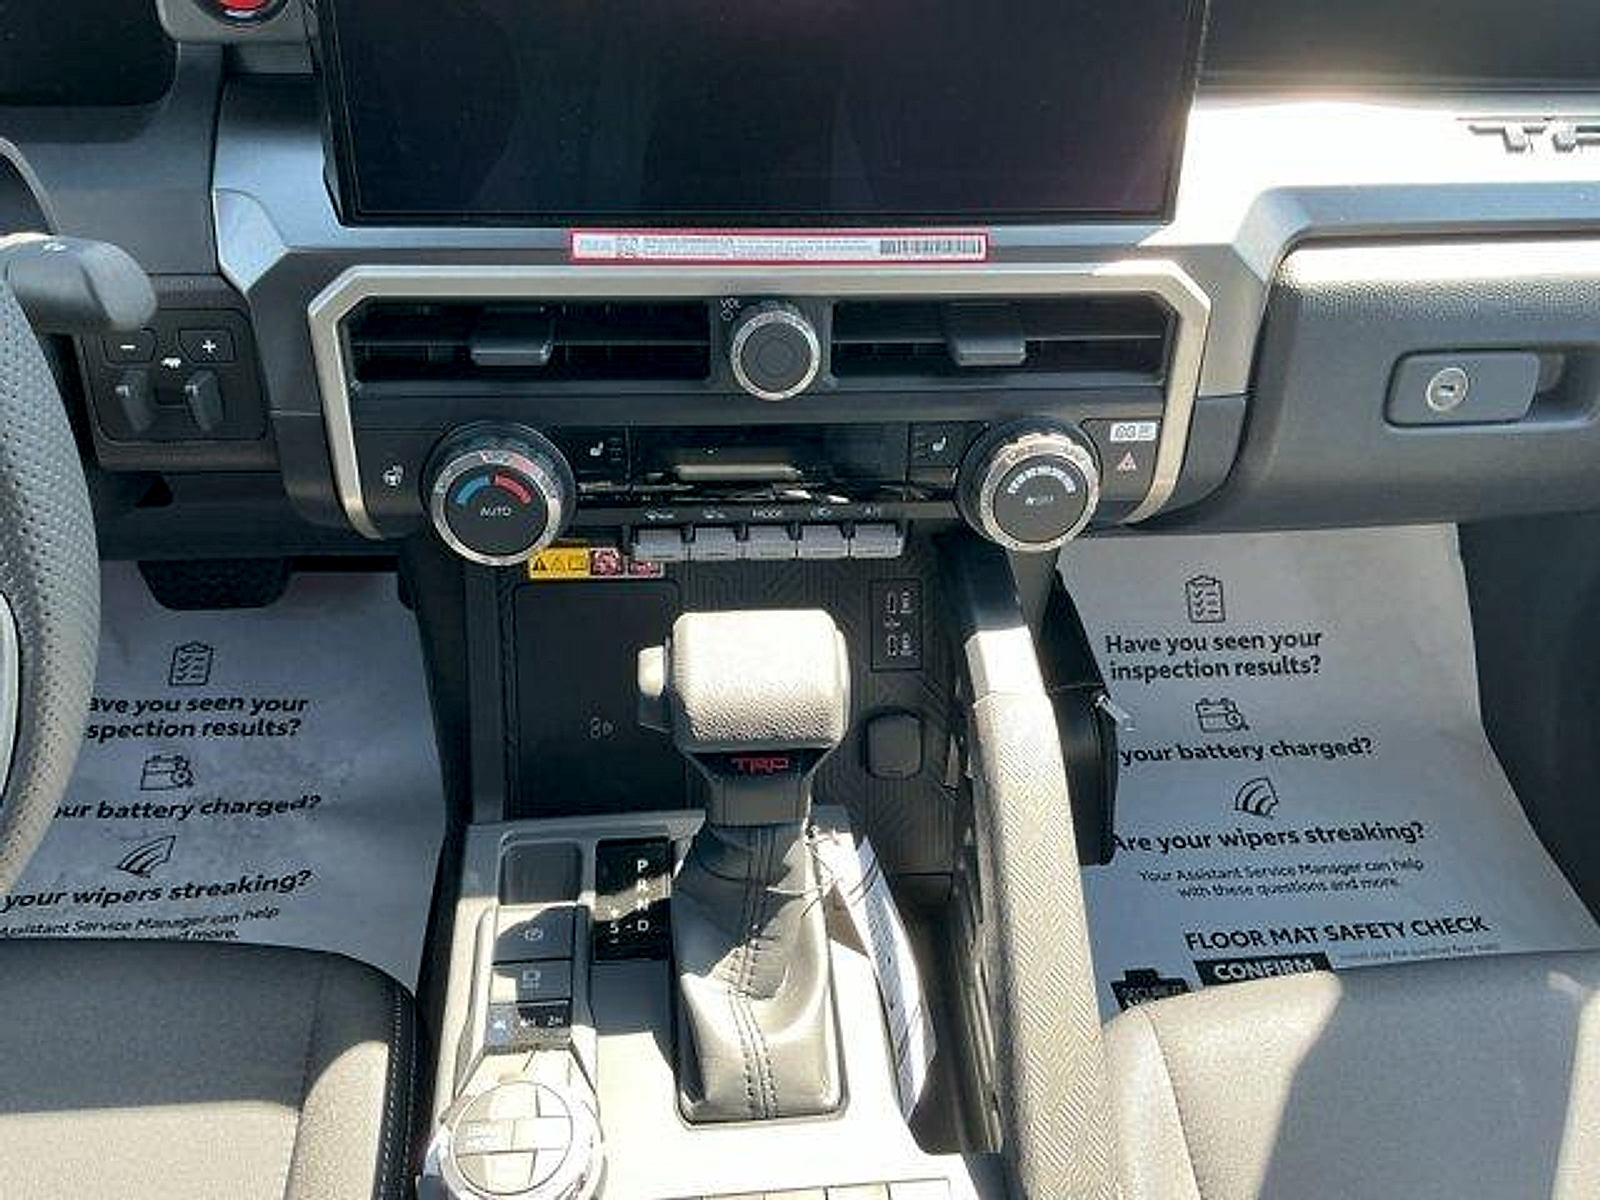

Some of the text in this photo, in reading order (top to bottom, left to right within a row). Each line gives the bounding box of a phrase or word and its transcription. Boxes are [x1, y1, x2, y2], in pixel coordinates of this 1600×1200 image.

[1106, 632, 1322, 656] Have you seen your
[1110, 655, 1321, 683] inspection results?
[90, 698, 308, 717] ave you seen your
[87, 718, 302, 743] spection results?
[1121, 738, 1373, 767] your battery charged?
[97, 801, 195, 821] battery
[200, 795, 322, 817] charged?
[1113, 822, 1425, 855] Are your wipers streaking?
[637, 859, 649, 873] P
[1139, 870, 1172, 881] Your
[1177, 867, 1243, 881] Assistant
[1246, 864, 1296, 878] Service
[1299, 863, 1360, 876] Manager
[0, 870, 312, 913] your wipers streaking?
[1212, 884, 1254, 896] these
[1257, 881, 1327, 898] questions
[637, 919, 649, 932] D
[1184, 916, 1490, 950] FLOOR MAT SAFETY CHECK
[1212, 957, 1316, 981] CONFIRM
